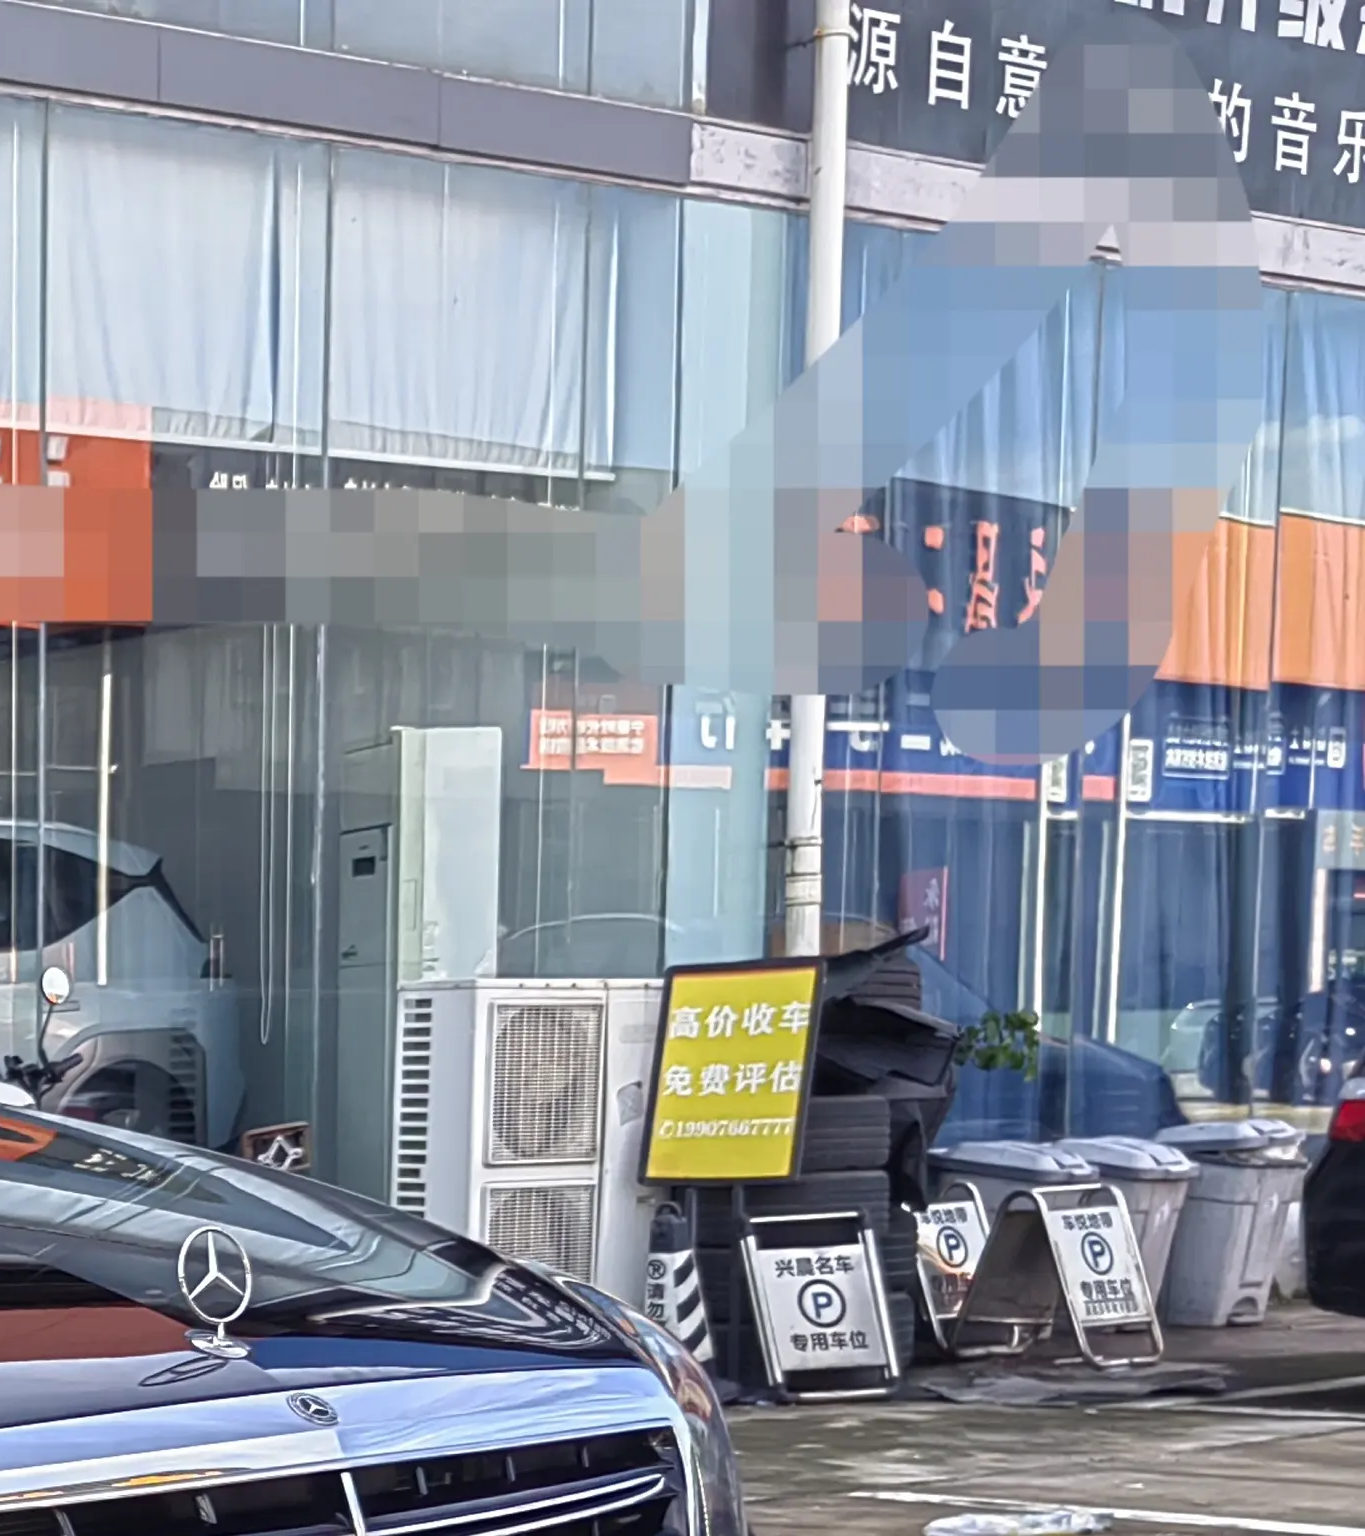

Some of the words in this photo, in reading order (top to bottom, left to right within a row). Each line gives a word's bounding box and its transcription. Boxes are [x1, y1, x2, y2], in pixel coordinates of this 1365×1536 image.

[669, 1001, 812, 1040] 高价收车
[662, 1060, 803, 1097] 免费评估
[790, 1331, 870, 1352] 专用车位
